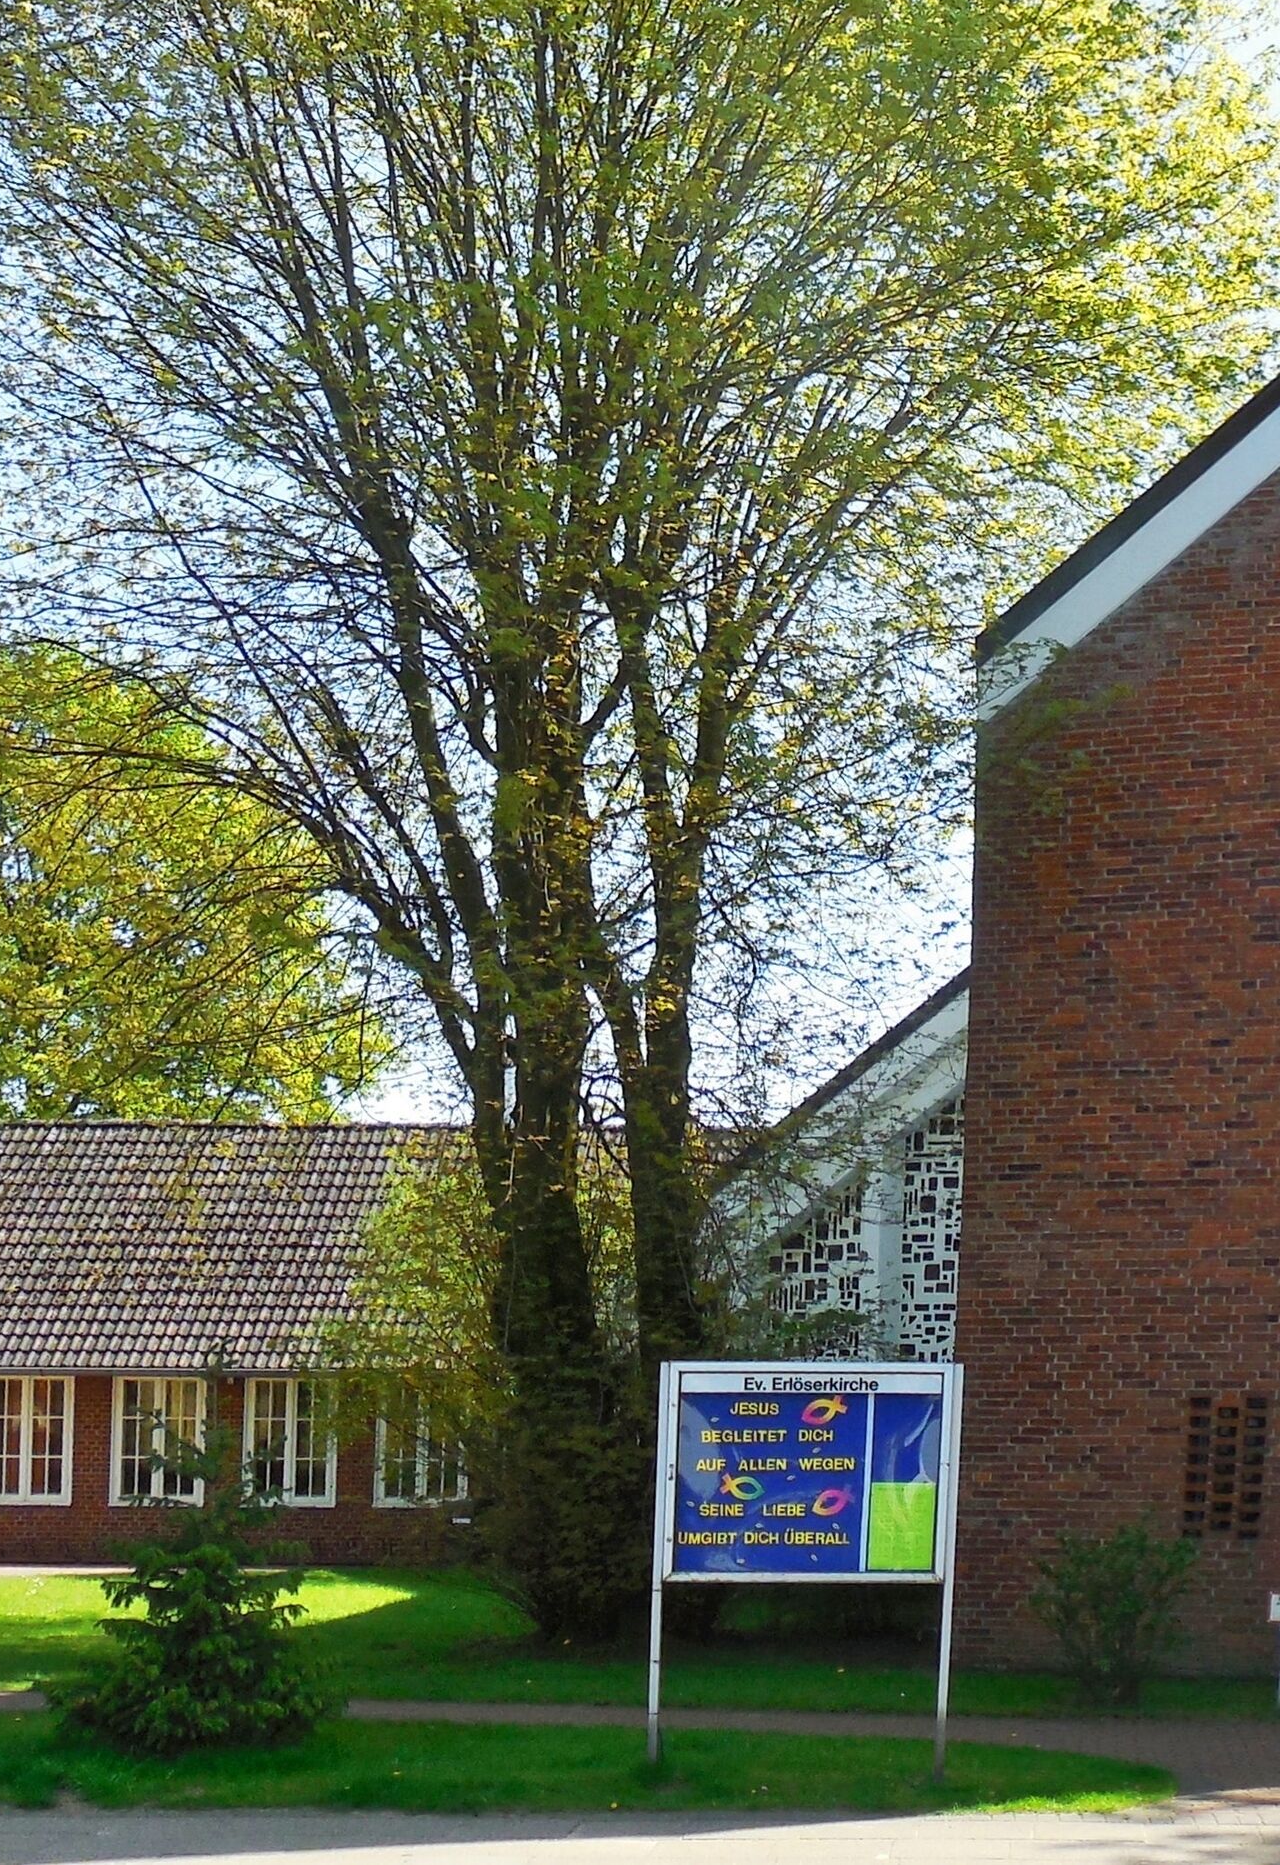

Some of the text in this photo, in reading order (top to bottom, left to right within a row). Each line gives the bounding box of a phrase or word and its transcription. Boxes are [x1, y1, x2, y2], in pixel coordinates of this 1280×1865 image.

[743, 1376, 880, 1392] Ev. Erlöserkirche
[730, 1402, 780, 1416] JESUS
[701, 1430, 834, 1443] BEGLEITET DICH
[696, 1457, 855, 1472] AUF ALLEN WEGEN
[699, 1503, 806, 1517] SEINE LIEBE
[678, 1528, 850, 1545] UMGIBT DICH ÜBERALL
